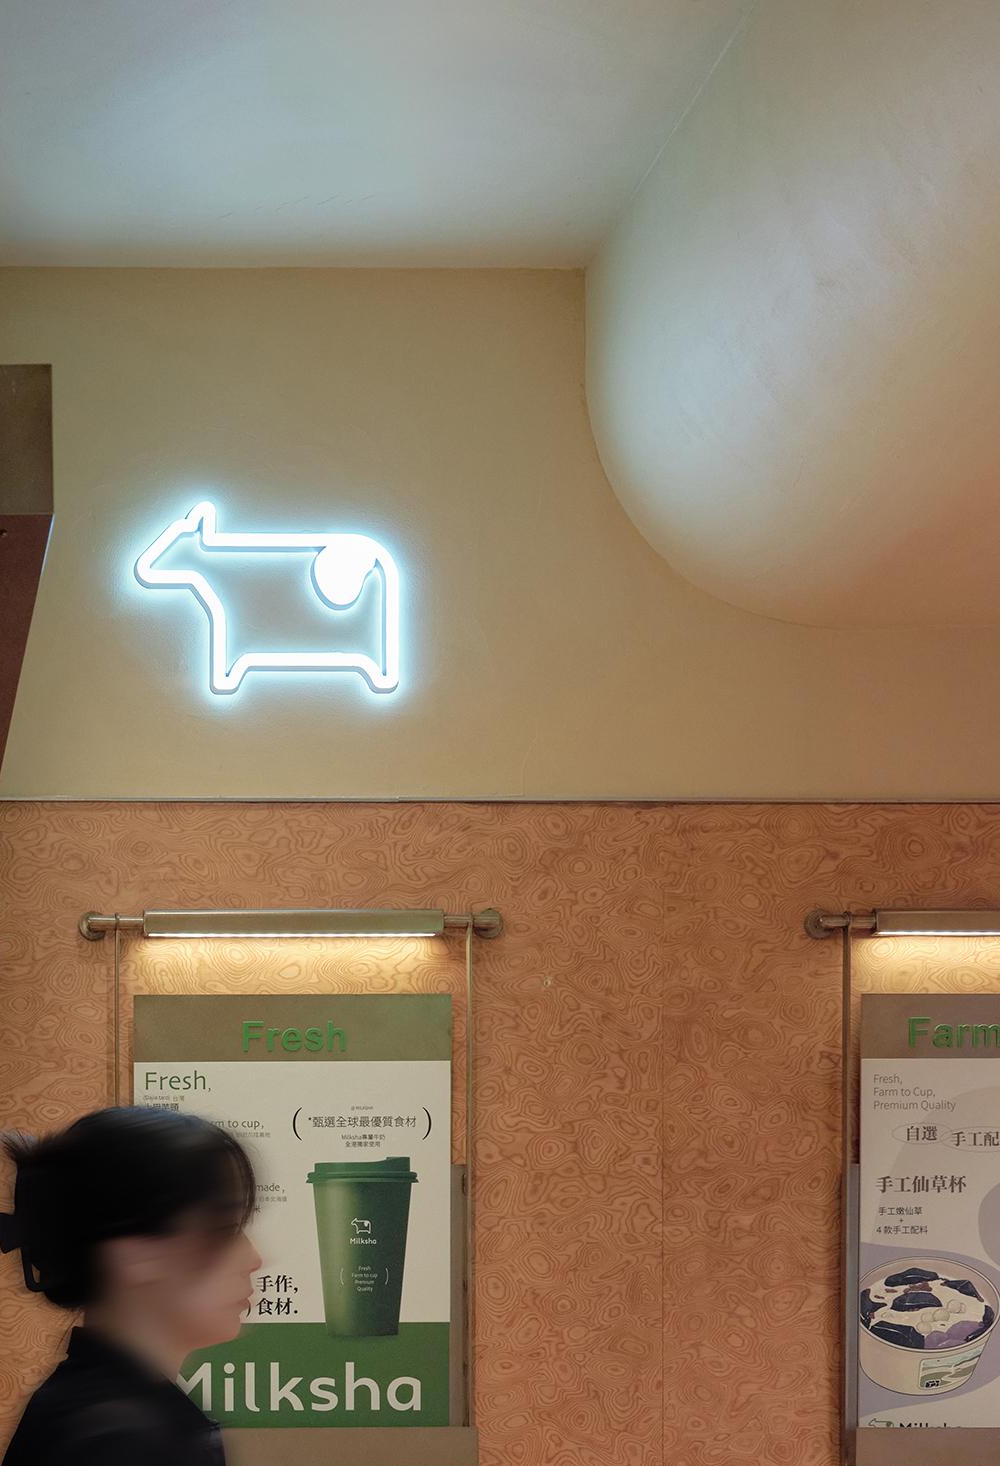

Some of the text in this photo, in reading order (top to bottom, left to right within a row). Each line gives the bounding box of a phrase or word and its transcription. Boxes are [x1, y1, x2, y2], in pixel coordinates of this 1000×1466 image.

[241, 1020, 348, 1053] Fresh
[908, 1016, 1000, 1049] Farm
[145, 1070, 212, 1092] Fresh,
[873, 1074, 903, 1085] Fresh,
[873, 1087, 936, 1099] Farm to Cup,
[873, 1100, 957, 1113] Premium Quality
[228, 1119, 239, 1129] to
[241, 1120, 265, 1130] cup,
[906, 1125, 938, 1142] 自選
[876, 1175, 967, 1194] 手工仙草杯
[350, 1237, 377, 1245] Milksha
[256, 1275, 298, 1293] 手作,
[256, 1298, 298, 1315] 食材.
[177, 1361, 422, 1412] Milksha
